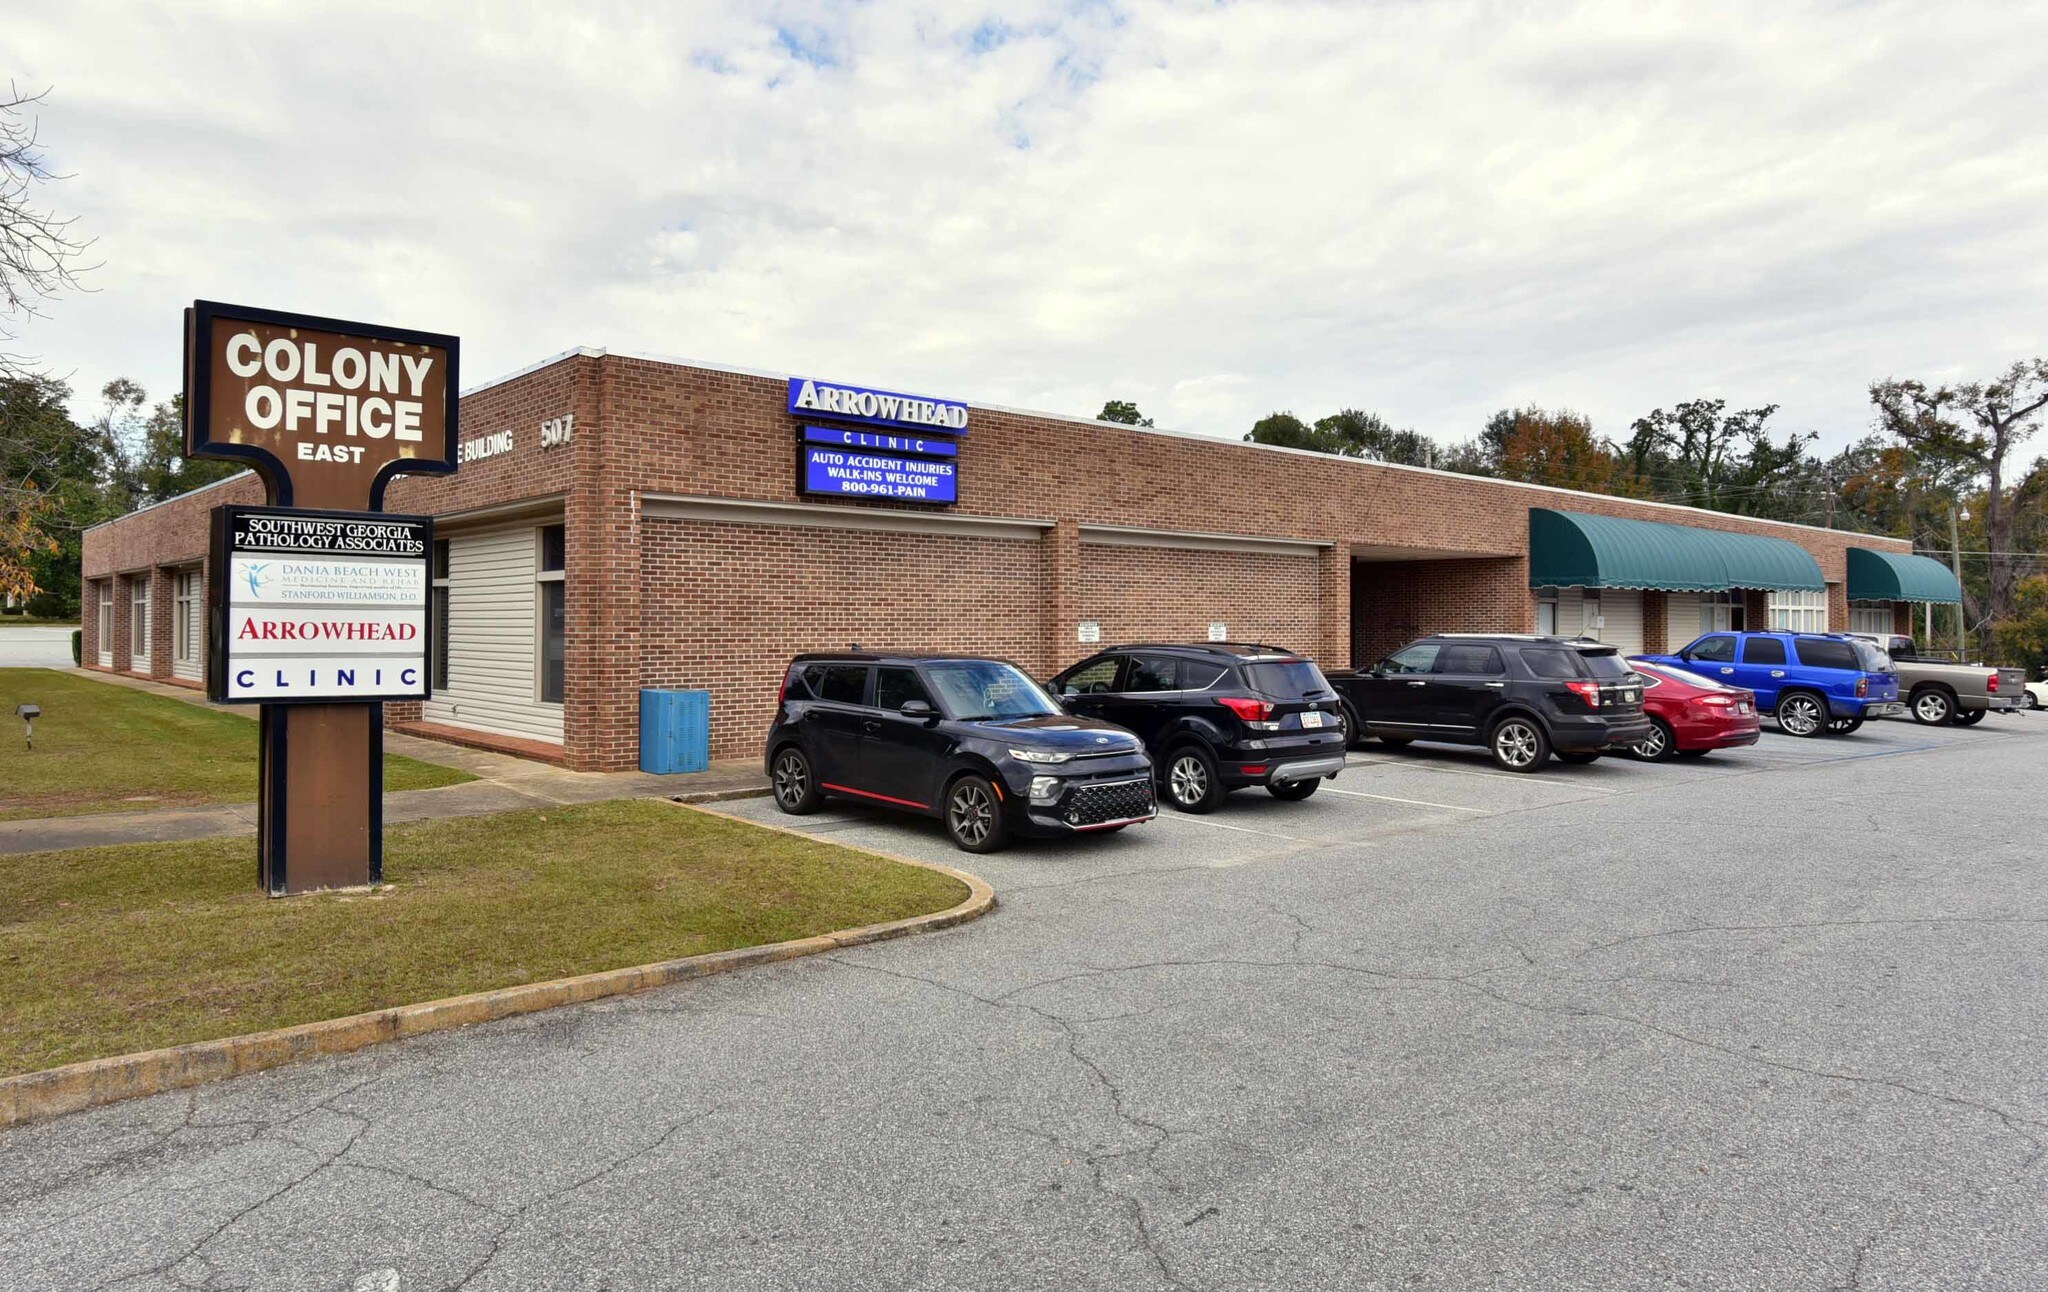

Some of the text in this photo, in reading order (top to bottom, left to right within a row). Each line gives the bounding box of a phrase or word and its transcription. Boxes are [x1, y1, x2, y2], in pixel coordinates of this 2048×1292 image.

[226, 333, 434, 397] COLONY
[245, 385, 423, 442] OFFICE
[794, 380, 968, 429] ARROWHEAD
[541, 414, 574, 448] 507
[465, 430, 513, 462] BUILDING
[843, 432, 924, 452] CLINIC
[297, 442, 366, 464] EAST
[811, 452, 953, 476] AUTO ACCIDENT INJURIES
[827, 466, 938, 486] WALK-INS WELCOME
[841, 481, 926, 498] 800-961-PAIN
[249, 519, 411, 540] SOUTHWEST GEORGIA
[234, 531, 424, 552] PATHOLOGY ASSOCIATES
[281, 575, 345, 584] MEDICINE
[351, 577, 376, 585] AND
[282, 564, 419, 578] DANIA BEACH WEST
[281, 590, 335, 600] STANFORD
[237, 616, 417, 641] ARROWHEAD
[236, 668, 417, 688] CLINIC
